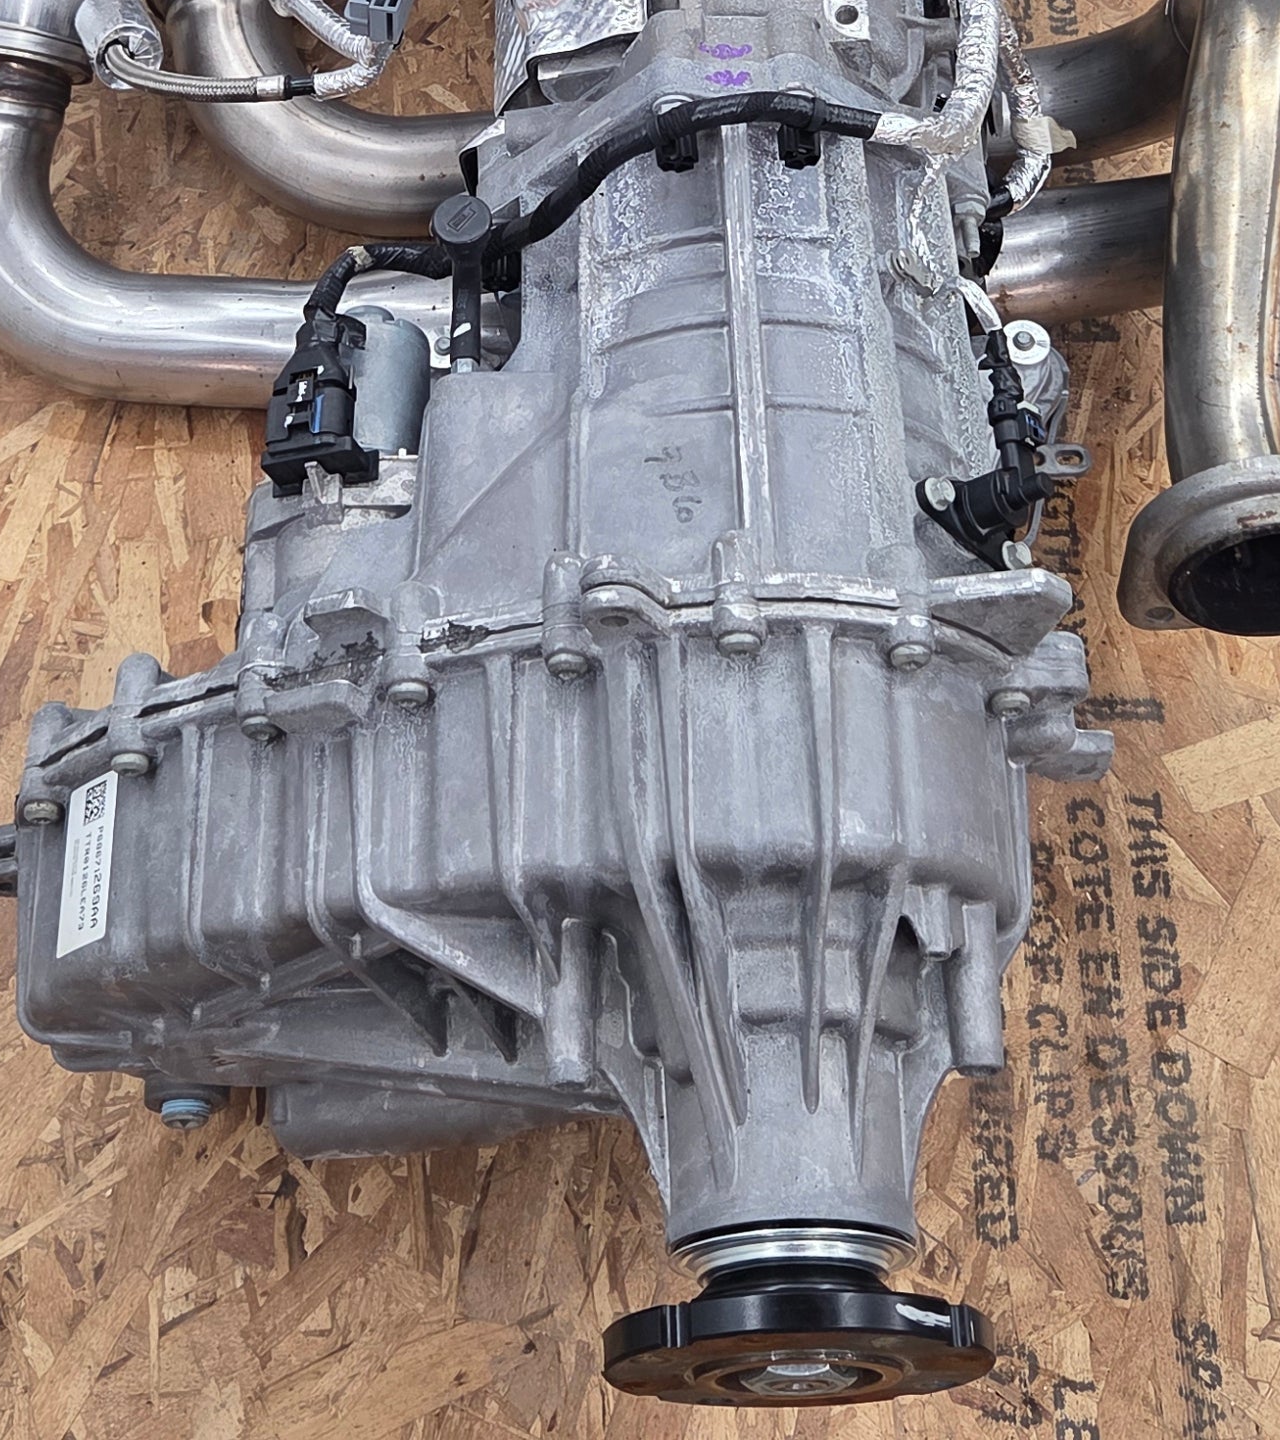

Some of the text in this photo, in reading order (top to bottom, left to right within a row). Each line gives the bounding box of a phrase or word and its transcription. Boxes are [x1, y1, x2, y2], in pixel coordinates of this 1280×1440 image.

[1124, 790, 1171, 899] THIS
[1066, 797, 1150, 1302] COTE EN DESSOUS
[1136, 914, 1187, 1032] SIDE
[1027, 1003, 1078, 1165] CLIPS
[1152, 1050, 1208, 1227] DOWN
